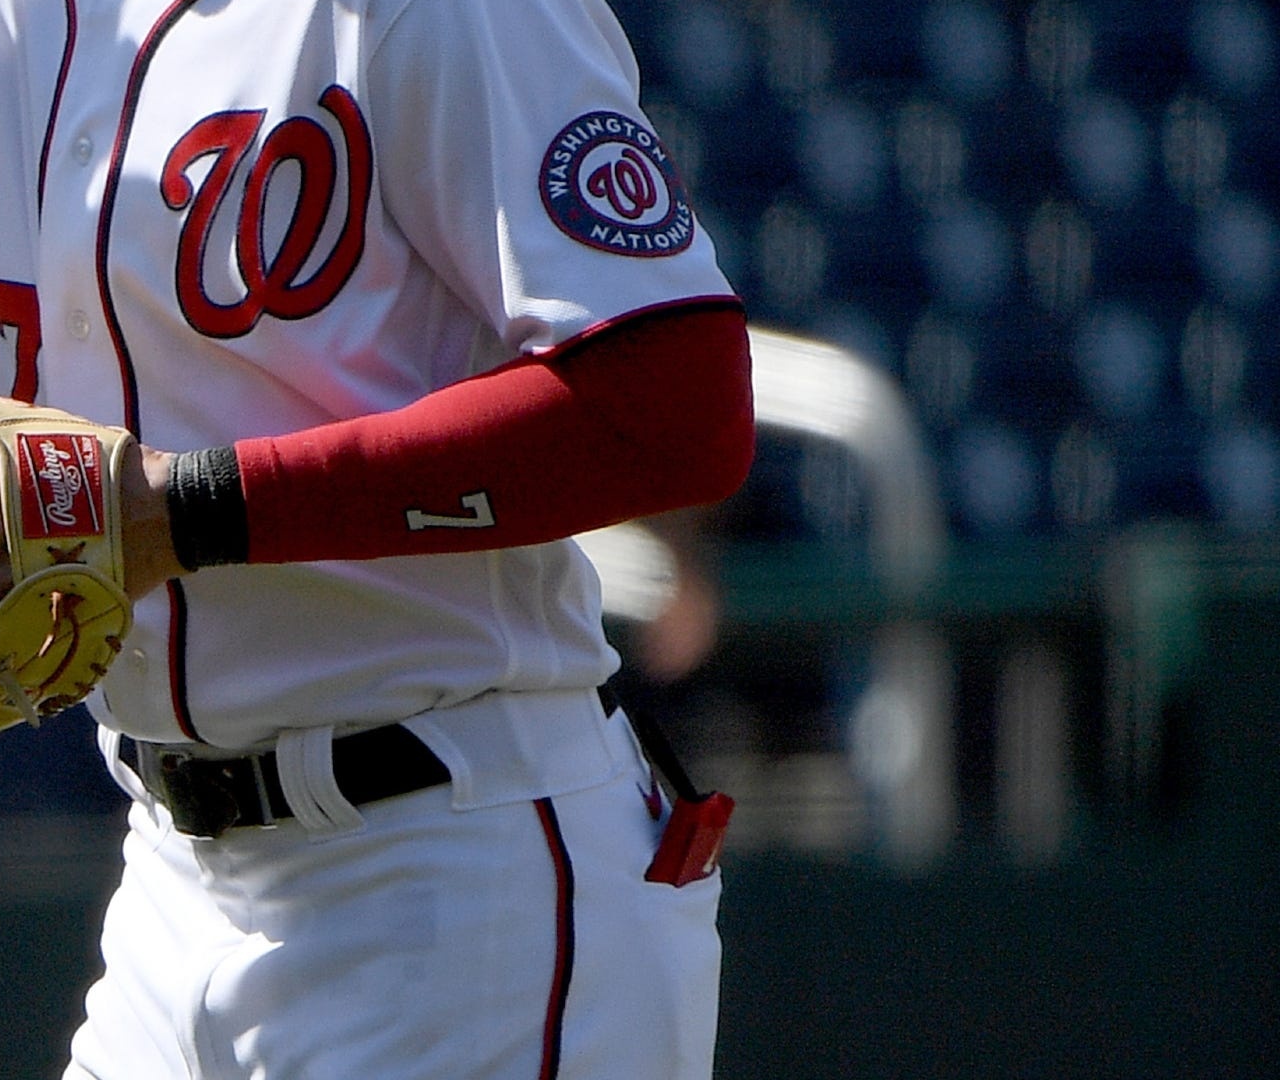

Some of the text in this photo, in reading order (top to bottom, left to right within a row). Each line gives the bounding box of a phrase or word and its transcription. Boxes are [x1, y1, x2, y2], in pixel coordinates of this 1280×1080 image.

[548, 118, 667, 200] WASHINGTON
[586, 147, 658, 220] W
[160, 84, 374, 339] W
[590, 201, 690, 250] NATIONALS
[39, 440, 76, 526] Rawlings
[405, 490, 496, 531] 7
